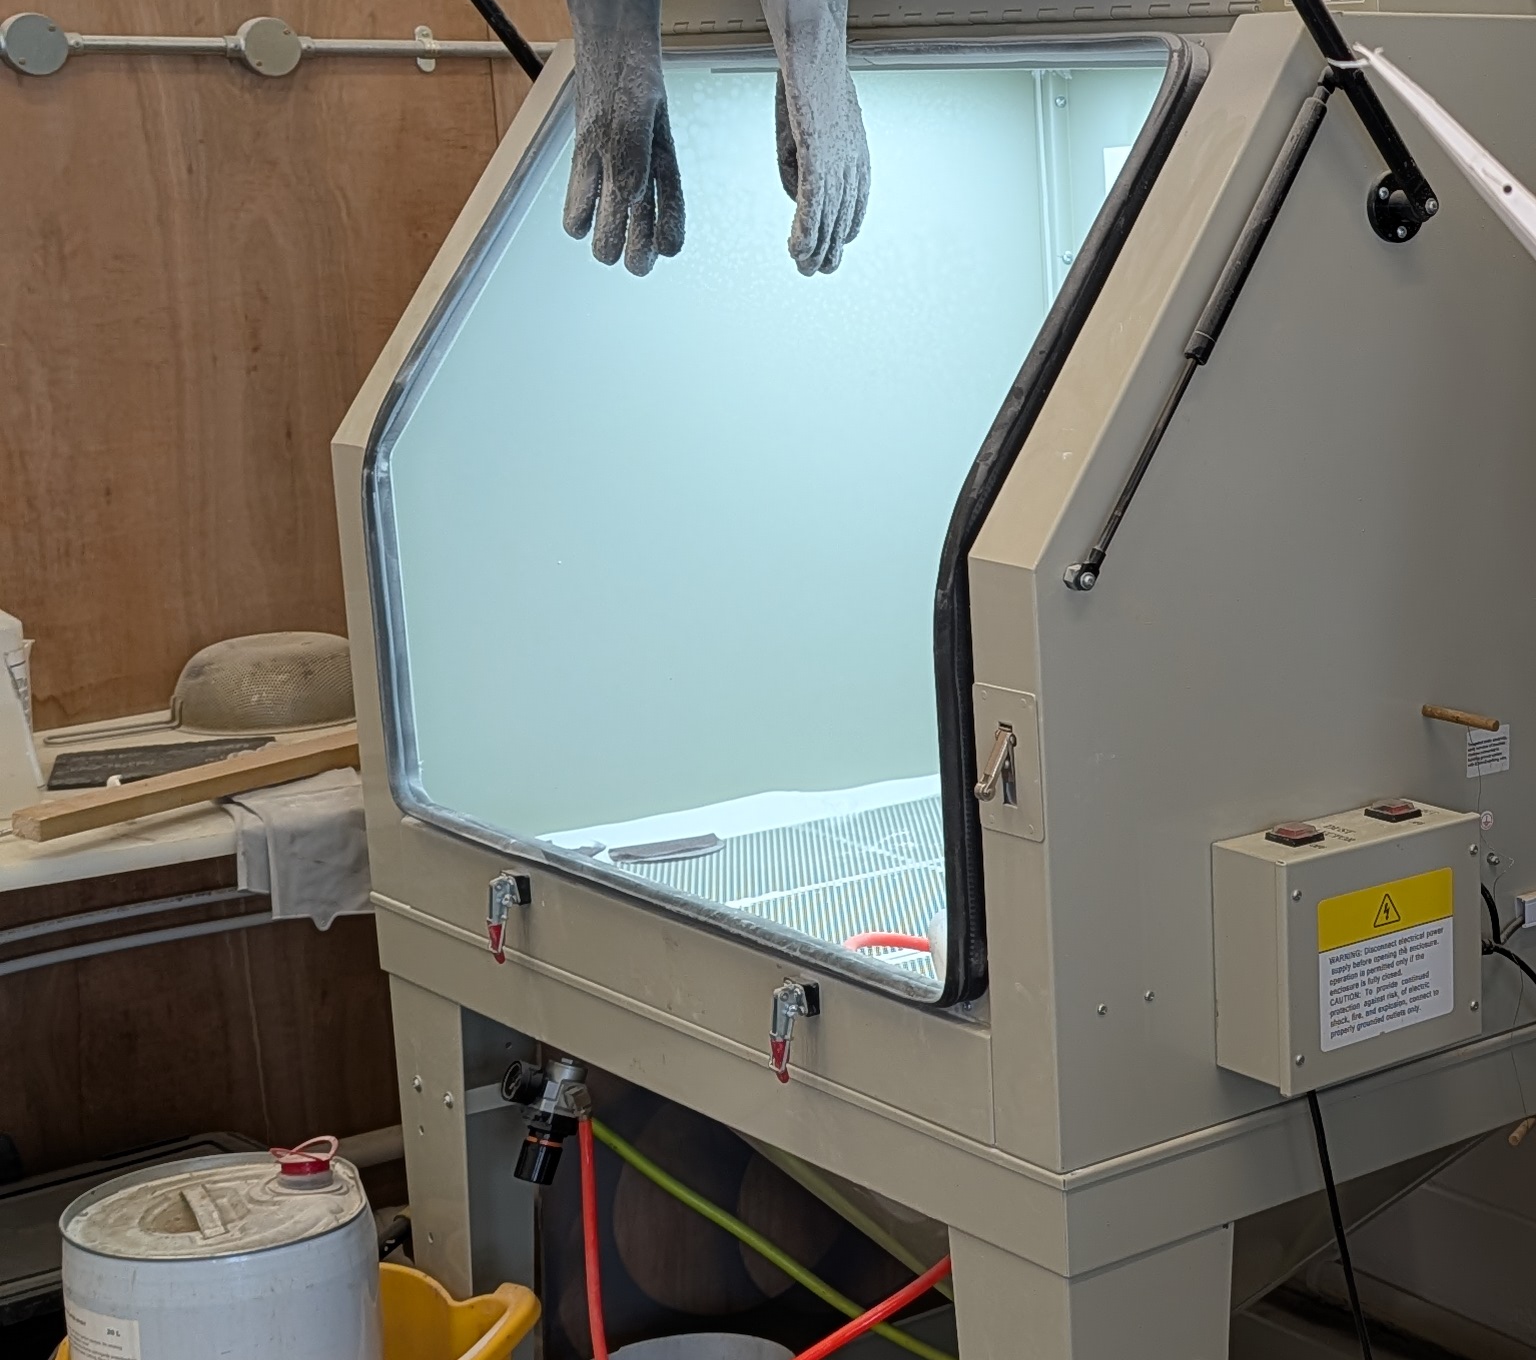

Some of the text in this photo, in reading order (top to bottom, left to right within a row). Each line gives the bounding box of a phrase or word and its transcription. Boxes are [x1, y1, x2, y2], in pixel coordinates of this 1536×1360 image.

[1365, 940, 1396, 955] Disconnect
[1399, 932, 1424, 946] electrical
[1427, 928, 1444, 939] power
[1330, 972, 1358, 987] operation
[1367, 961, 1394, 976] permitted
[1396, 958, 1408, 968] only
[1415, 953, 1424, 961] the
[1332, 964, 1351, 977] supply
[1353, 957, 1372, 969] before
[1374, 951, 1397, 964] opening
[1399, 947, 1407, 956] the
[1330, 982, 1359, 996] enclosure
[1368, 976, 1380, 987] fully
[1365, 988, 1373, 996] To
[1376, 981, 1398, 994] provide
[1401, 971, 1429, 986] continued
[1330, 981, 1430, 1019] protection against risk of electric
[1366, 1008, 1376, 1017] and
[1409, 991, 1432, 1004] connect
[1331, 1025, 1355, 1040] properly
[1357, 1016, 1384, 1032] grounded
[1386, 1009, 1406, 1021] outlets
